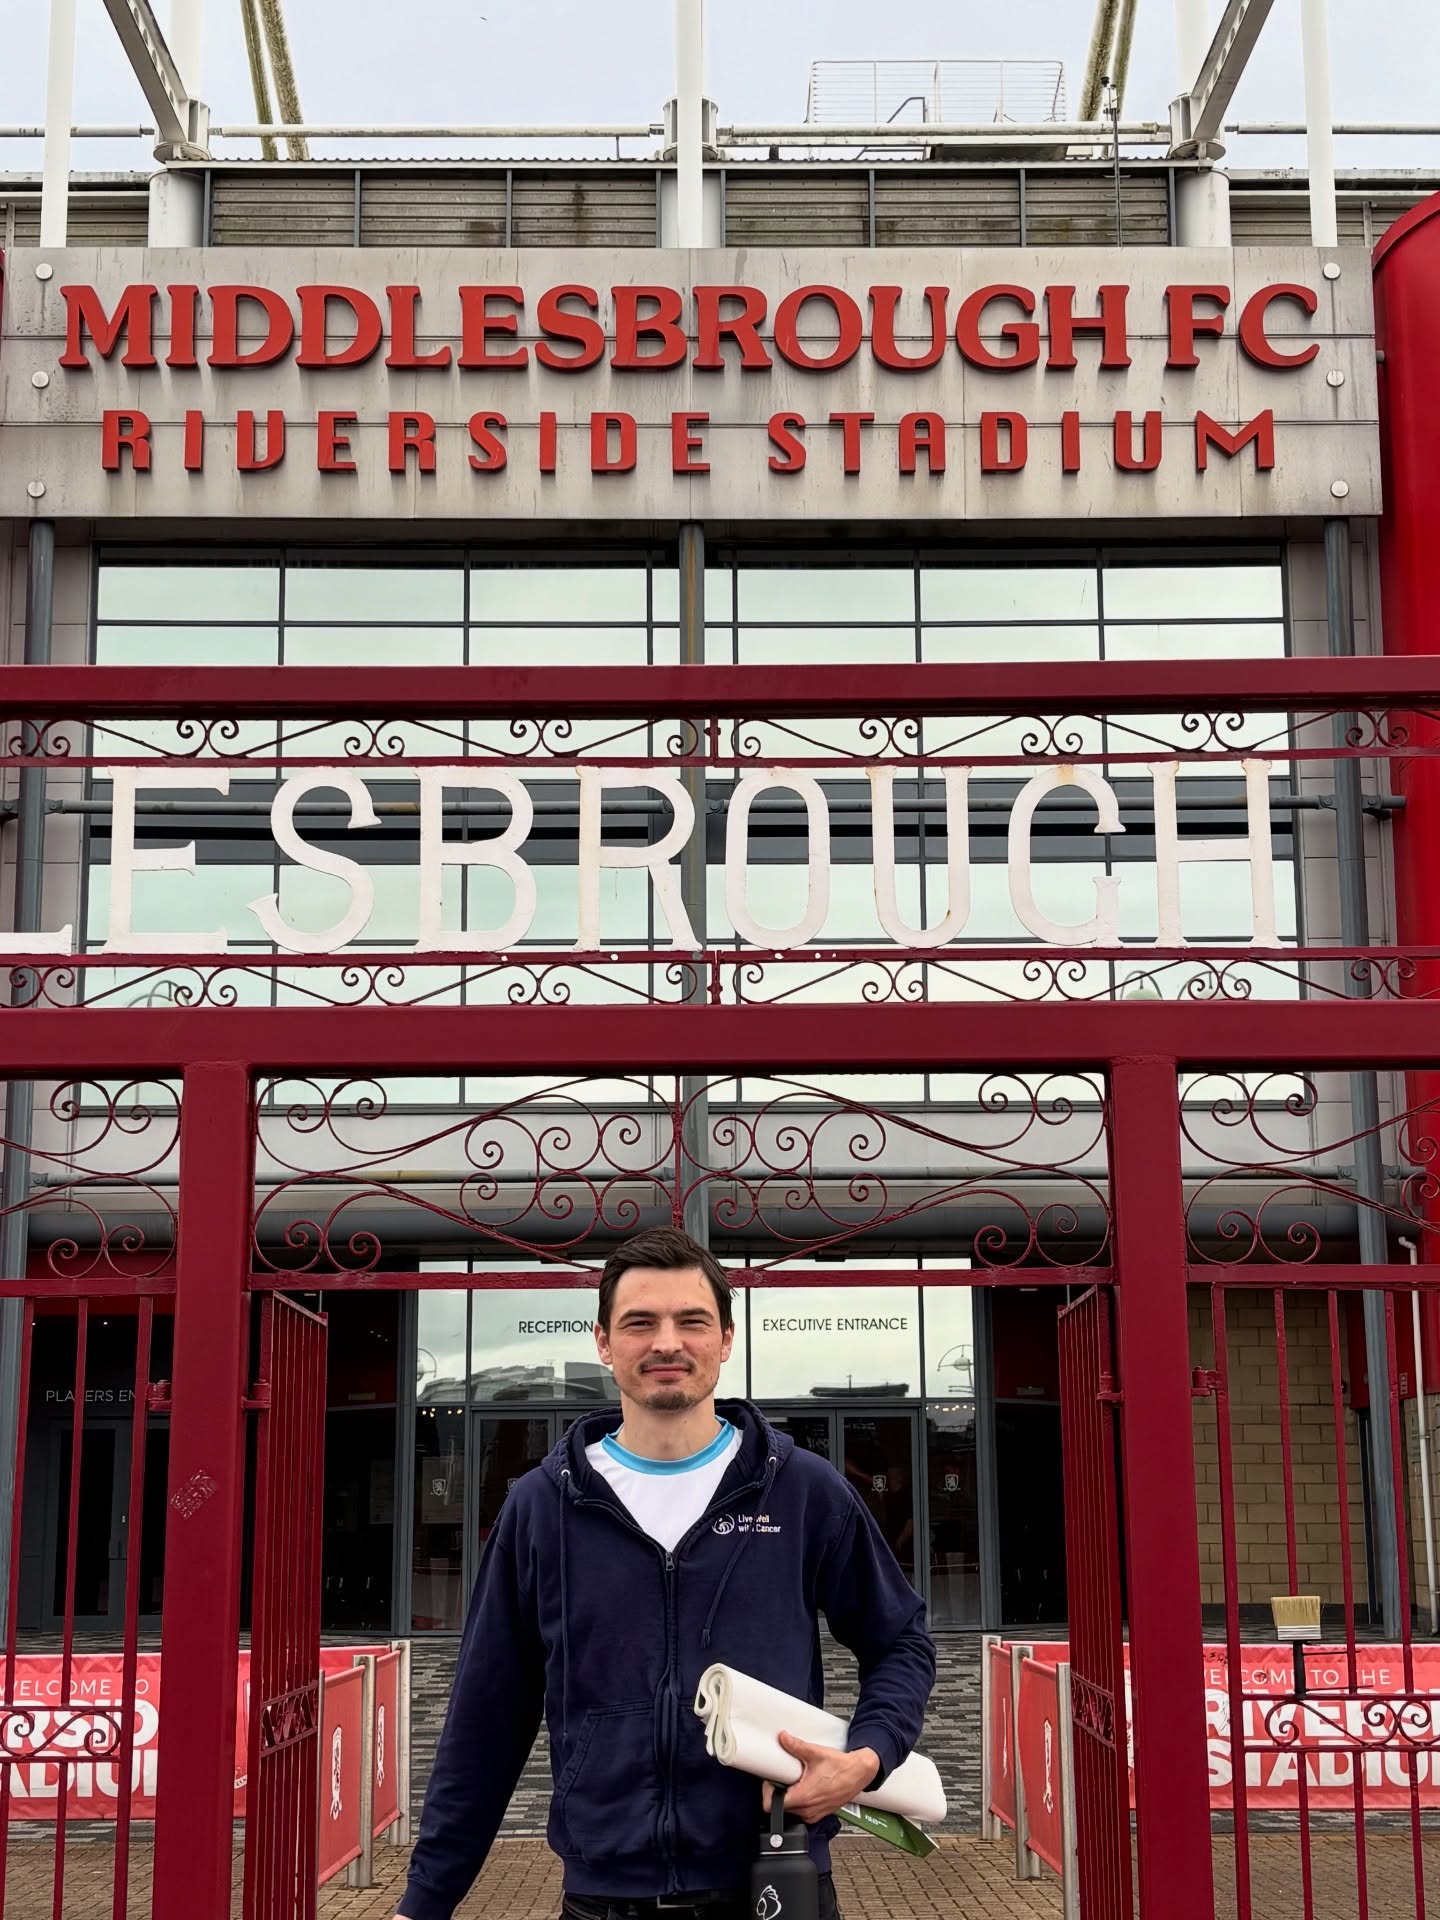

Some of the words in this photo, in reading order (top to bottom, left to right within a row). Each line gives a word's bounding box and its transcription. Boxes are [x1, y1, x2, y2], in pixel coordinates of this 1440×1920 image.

[59, 284, 1131, 371] MIDDLESBROUGH
[1165, 283, 1320, 369] FC
[101, 410, 711, 473] RIVERSIDE
[767, 409, 1276, 473] STADIUM
[518, 1320, 594, 1334] RECEPTION
[762, 1318, 832, 1331] EXECUTIVE
[837, 1317, 908, 1331] ENTRANCE
[46, 1390, 114, 1402] PLAERS
[738, 1524, 755, 1534] wit
[756, 1524, 782, 1534] Cancer
[1310, 1669, 1339, 1685] TO
[1356, 1669, 1392, 1685] HE
[0, 1679, 112, 1696] ELCOME
[1207, 1738, 1440, 1787] STADIU
